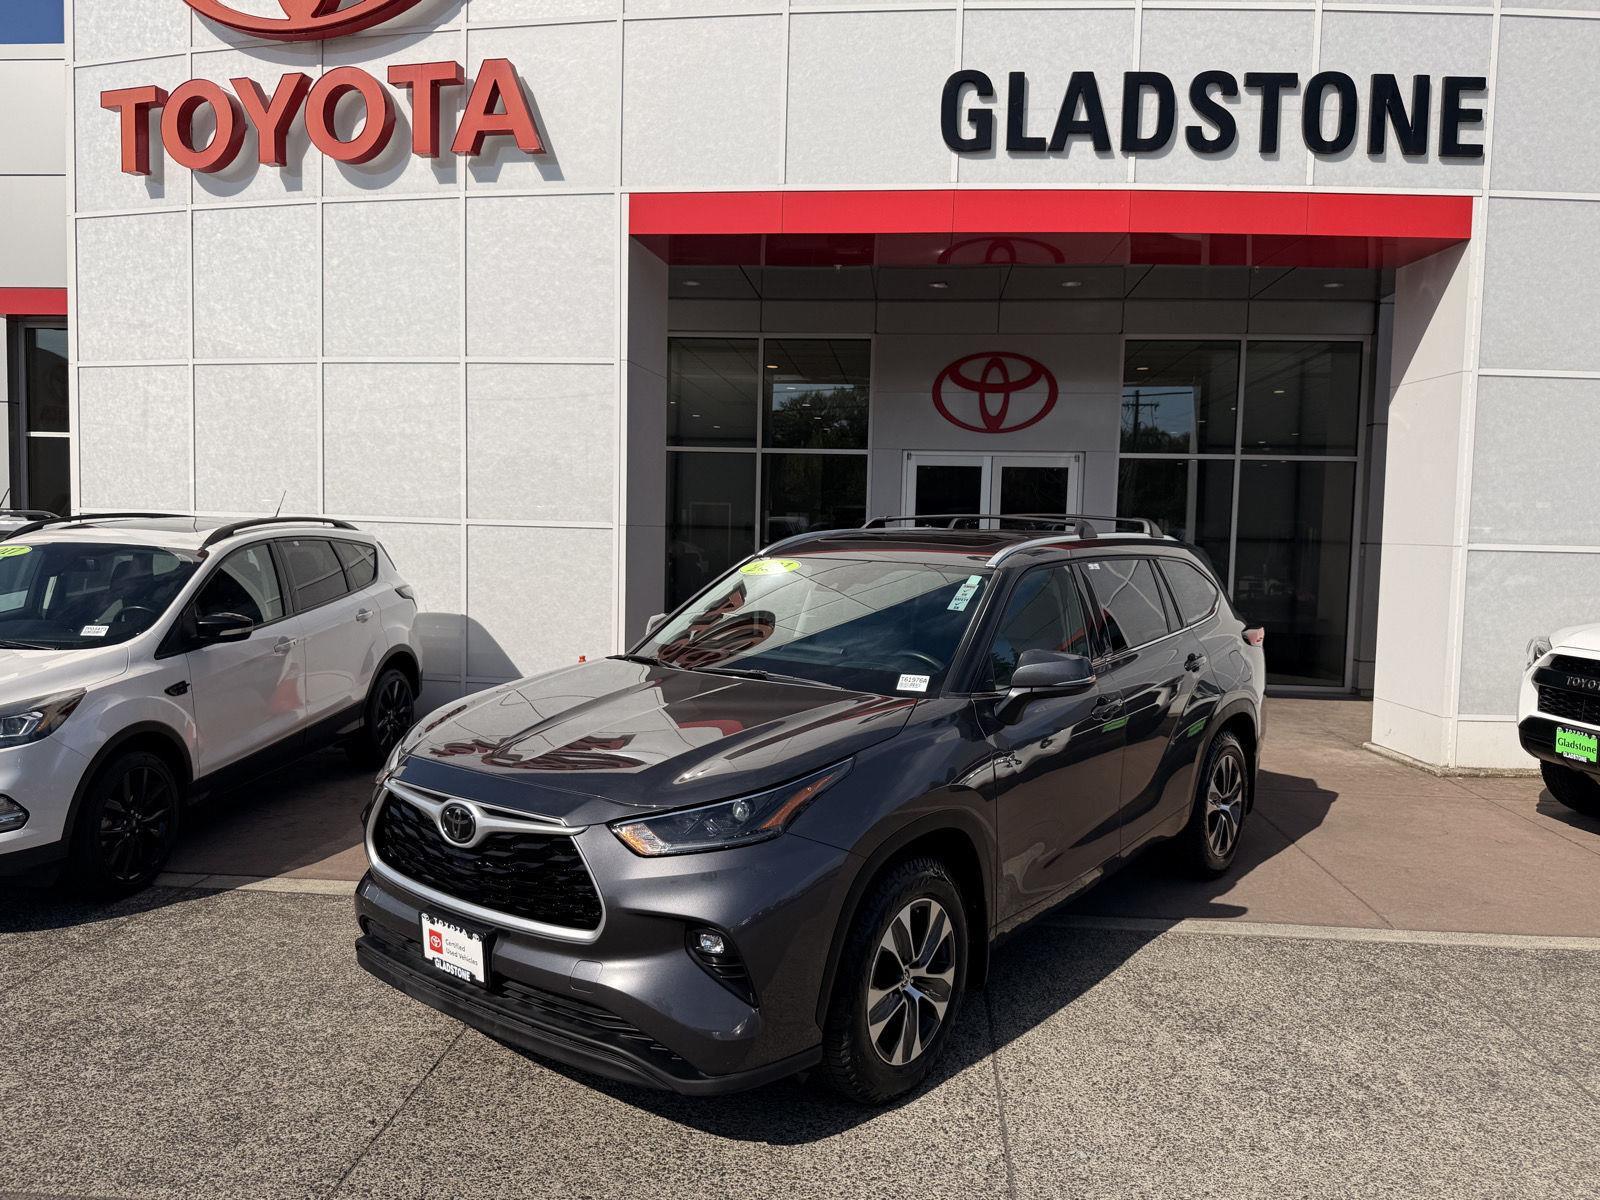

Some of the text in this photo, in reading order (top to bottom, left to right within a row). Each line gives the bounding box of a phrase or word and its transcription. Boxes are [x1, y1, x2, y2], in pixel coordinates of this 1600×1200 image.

[100, 58, 547, 176] TOYOTA
[940, 69, 1487, 157] GLADSTONE
[1557, 737, 1597, 754] Gladstone
[446, 948, 478, 966] Used Vehicles
[434, 958, 471, 982] GLADSTONE
